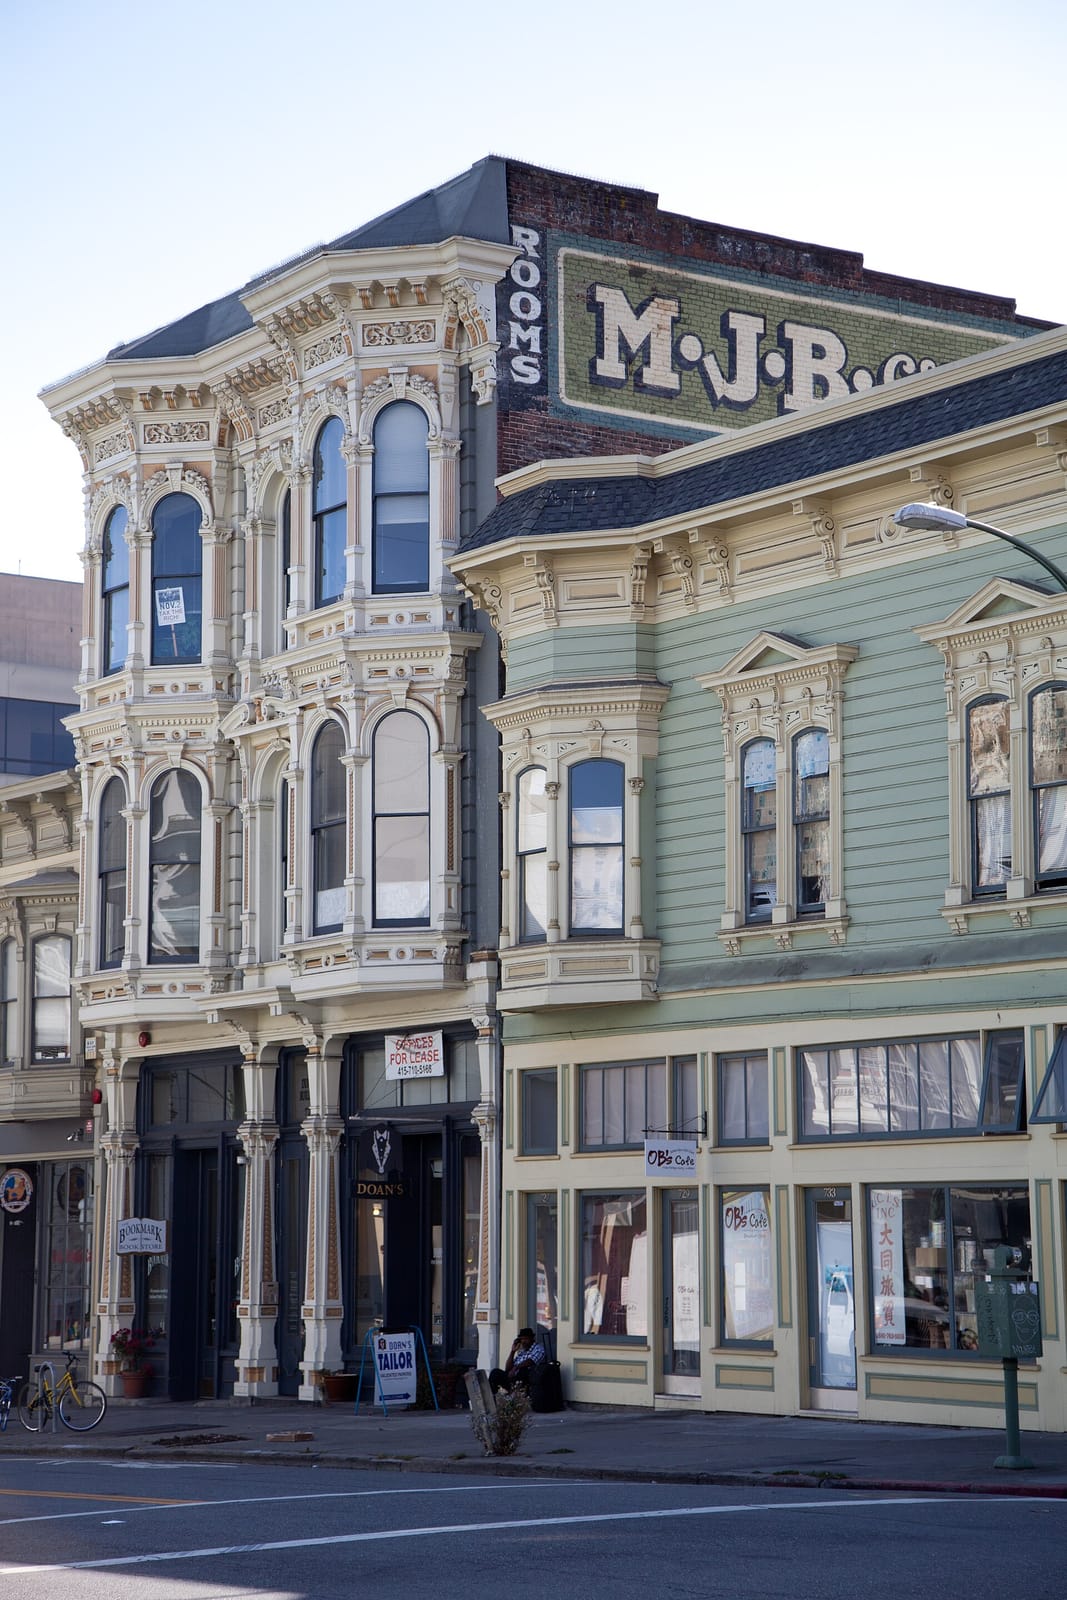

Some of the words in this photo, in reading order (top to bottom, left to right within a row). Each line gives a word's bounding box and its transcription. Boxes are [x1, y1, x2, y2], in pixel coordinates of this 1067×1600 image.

[509, 224, 541, 385] ROOMS
[395, 1035, 434, 1051] OFFICES
[390, 1052, 408, 1066] FOR
[410, 1049, 439, 1064] LEASE
[647, 1149, 673, 1167] OB's
[675, 1155, 695, 1167] Cafe
[356, 1183, 404, 1196] DOAN'S
[823, 1187, 837, 1199] 733
[724, 1206, 748, 1232] OB's
[749, 1213, 768, 1229] Cafe
[119, 1223, 162, 1243] BOOKMARK
[378, 1352, 413, 1371] TAILOR
